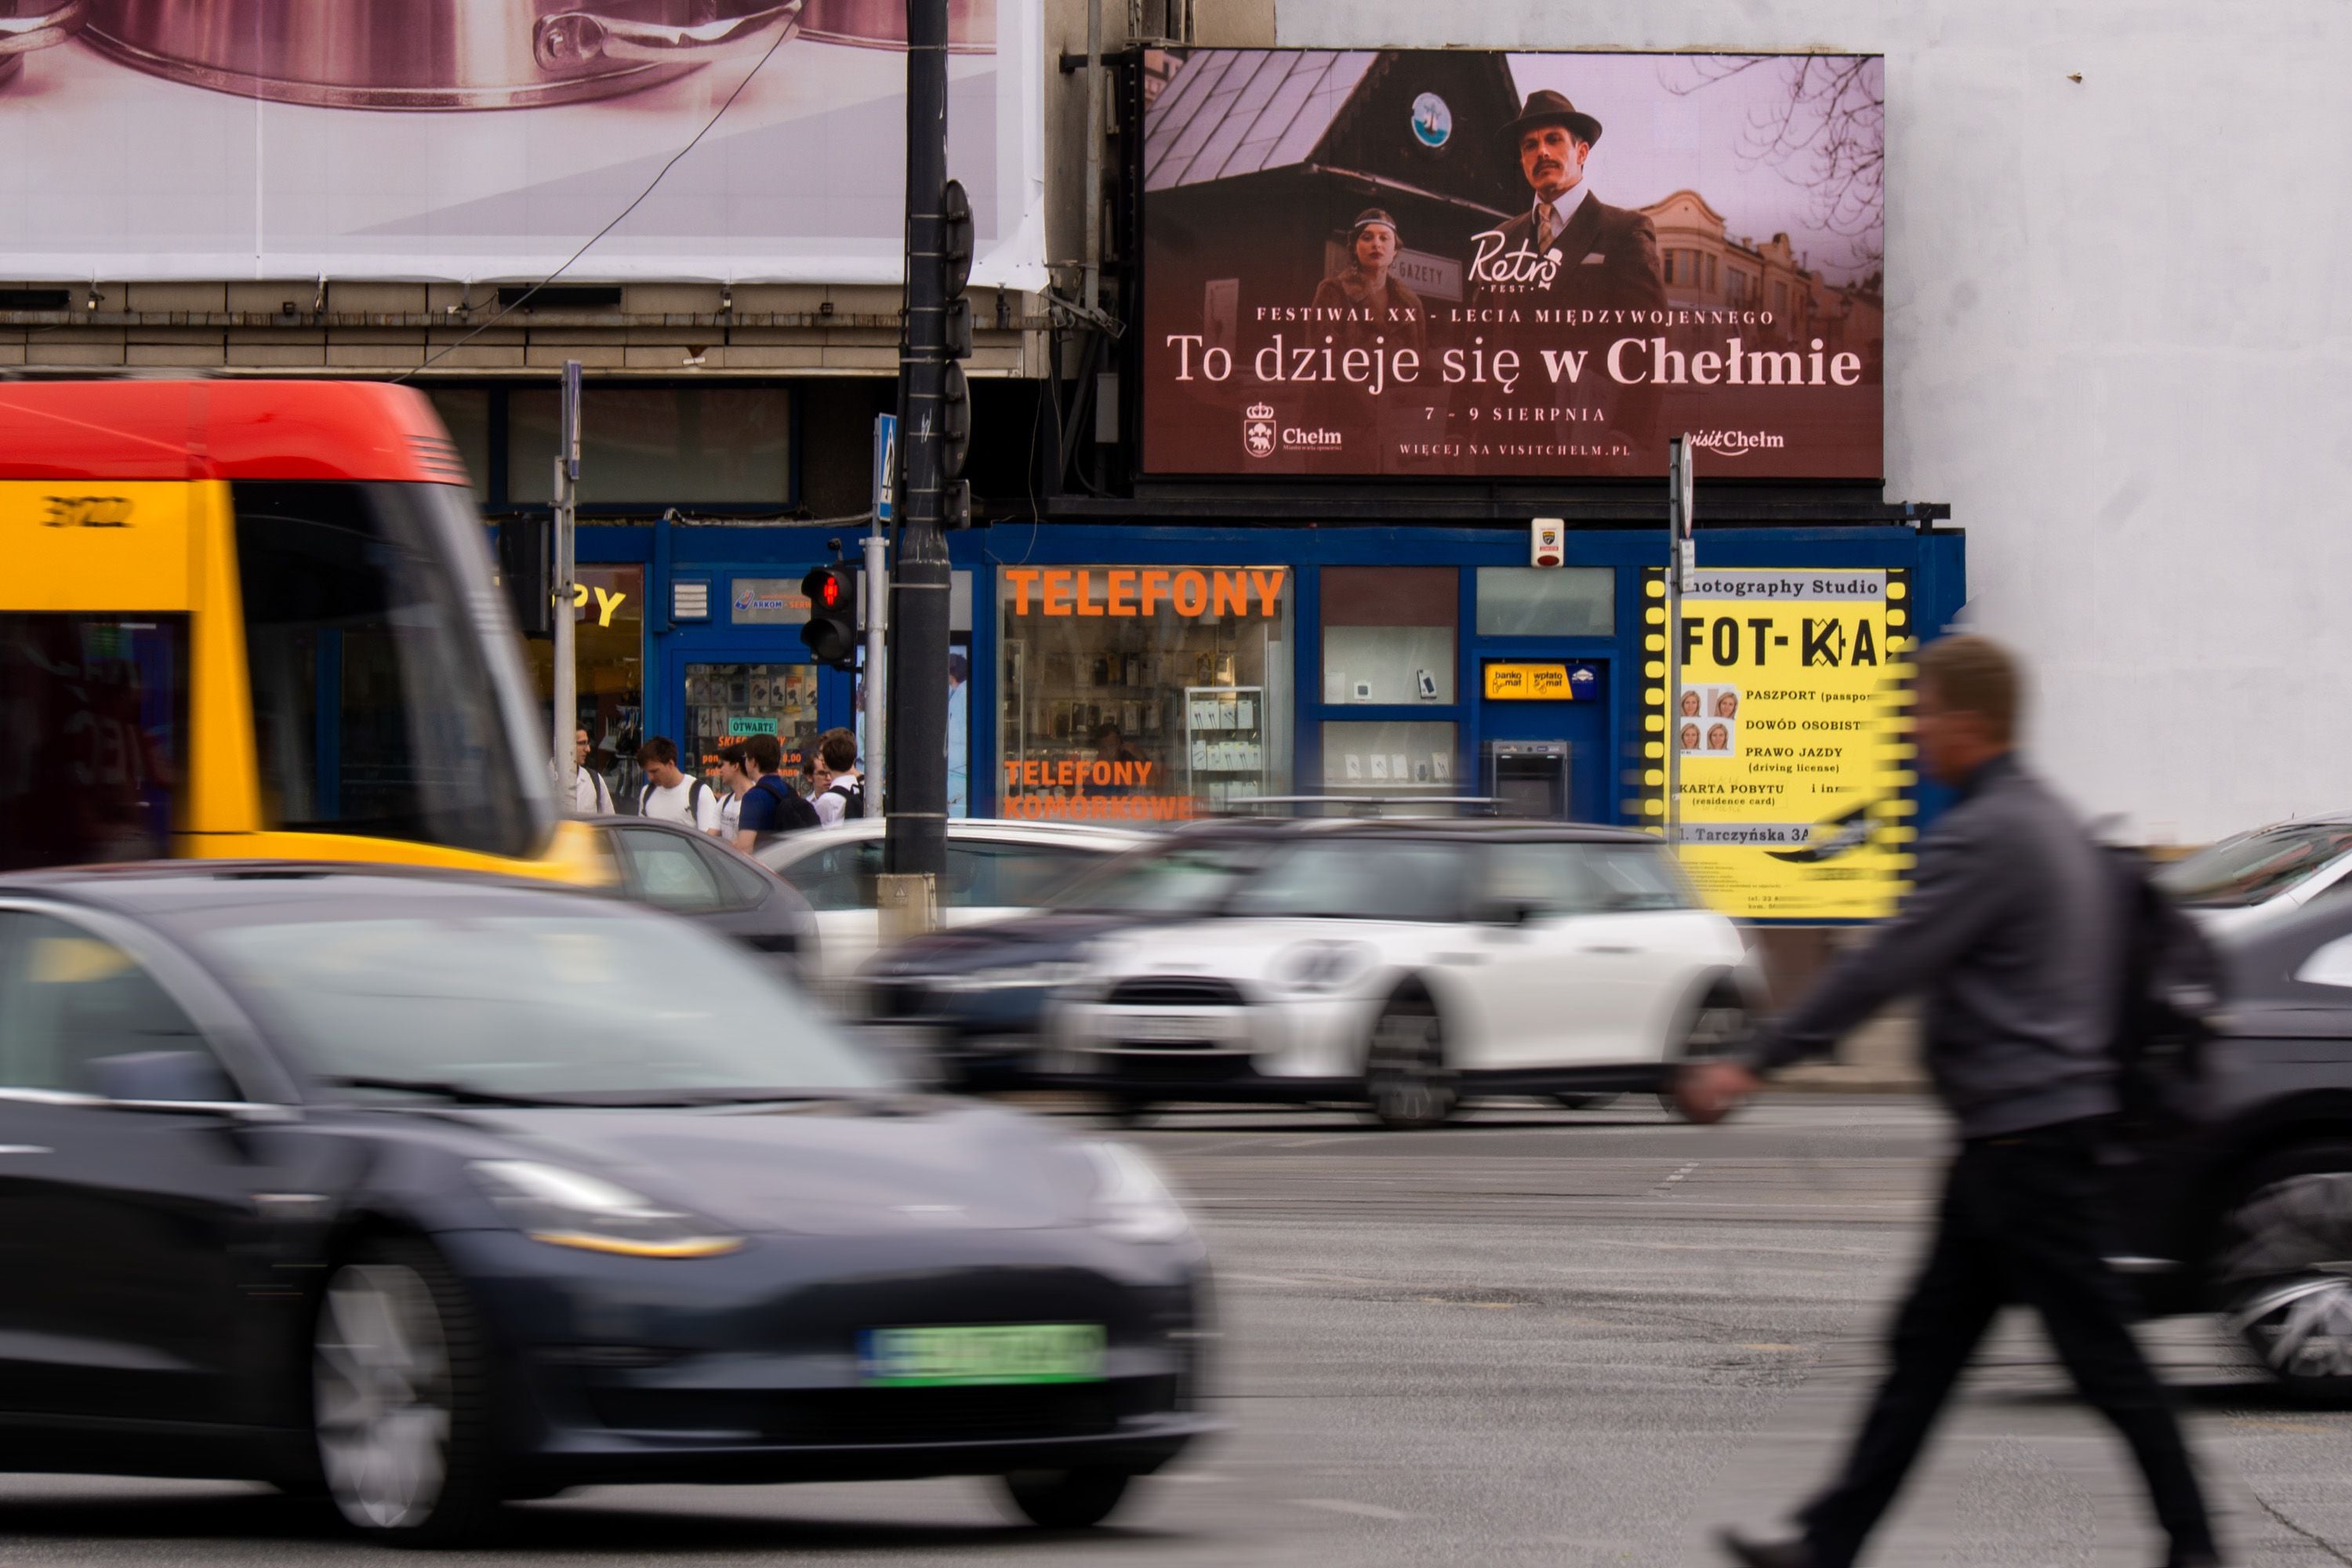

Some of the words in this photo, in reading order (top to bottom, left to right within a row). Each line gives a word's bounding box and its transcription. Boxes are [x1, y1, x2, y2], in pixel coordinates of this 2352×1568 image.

[1468, 230, 1558, 282] Retro
[1399, 261, 1443, 284] GAZETY
[1490, 284, 1525, 293] FEST
[1256, 307, 1375, 321] FESTIWAL
[1388, 307, 1417, 322] XX
[1450, 308, 1521, 323] LECIA
[1534, 309, 1774, 327] MIĘDZYWOJENNEGO
[1167, 334, 1233, 382] To
[1255, 333, 1420, 396] dzieje
[1442, 336, 1520, 394] się
[1540, 350, 1588, 384] w
[1606, 336, 1862, 387] Chełmie
[1425, 406, 1435, 420] 7
[1469, 407, 1479, 421] 9
[1493, 407, 1606, 422] SIERPNIA
[1282, 427, 1343, 445] Chełm
[1399, 444, 1460, 457] WIĘCEJ
[1469, 445, 1490, 456] NA
[1499, 445, 1632, 456] VISITCHELM.PL
[1004, 568, 1285, 618] TELEFONY
[1812, 579, 1879, 594] Studio
[1534, 671, 1563, 681] wpłato
[1745, 690, 1817, 700] PASZPORT
[732, 721, 775, 732] OTWARTE
[1745, 718, 1797, 731] DOWÓD
[1801, 720, 1864, 731] OSOBIST
[1745, 747, 1795, 757] PRAWO
[1798, 747, 1843, 757] JAZDY
[1004, 760, 1153, 786] TELEFONY
[1748, 762, 1793, 774] (driving
[1796, 762, 1840, 774] license)
[1679, 784, 1725, 794] KARTA
[1730, 784, 1784, 795] POBYTU
[1004, 788, 1194, 821] KOMÓRKOWE
[1692, 797, 1746, 807] (residence
[1749, 797, 1776, 807] card)
[1695, 827, 1785, 844] Tarczyńska
